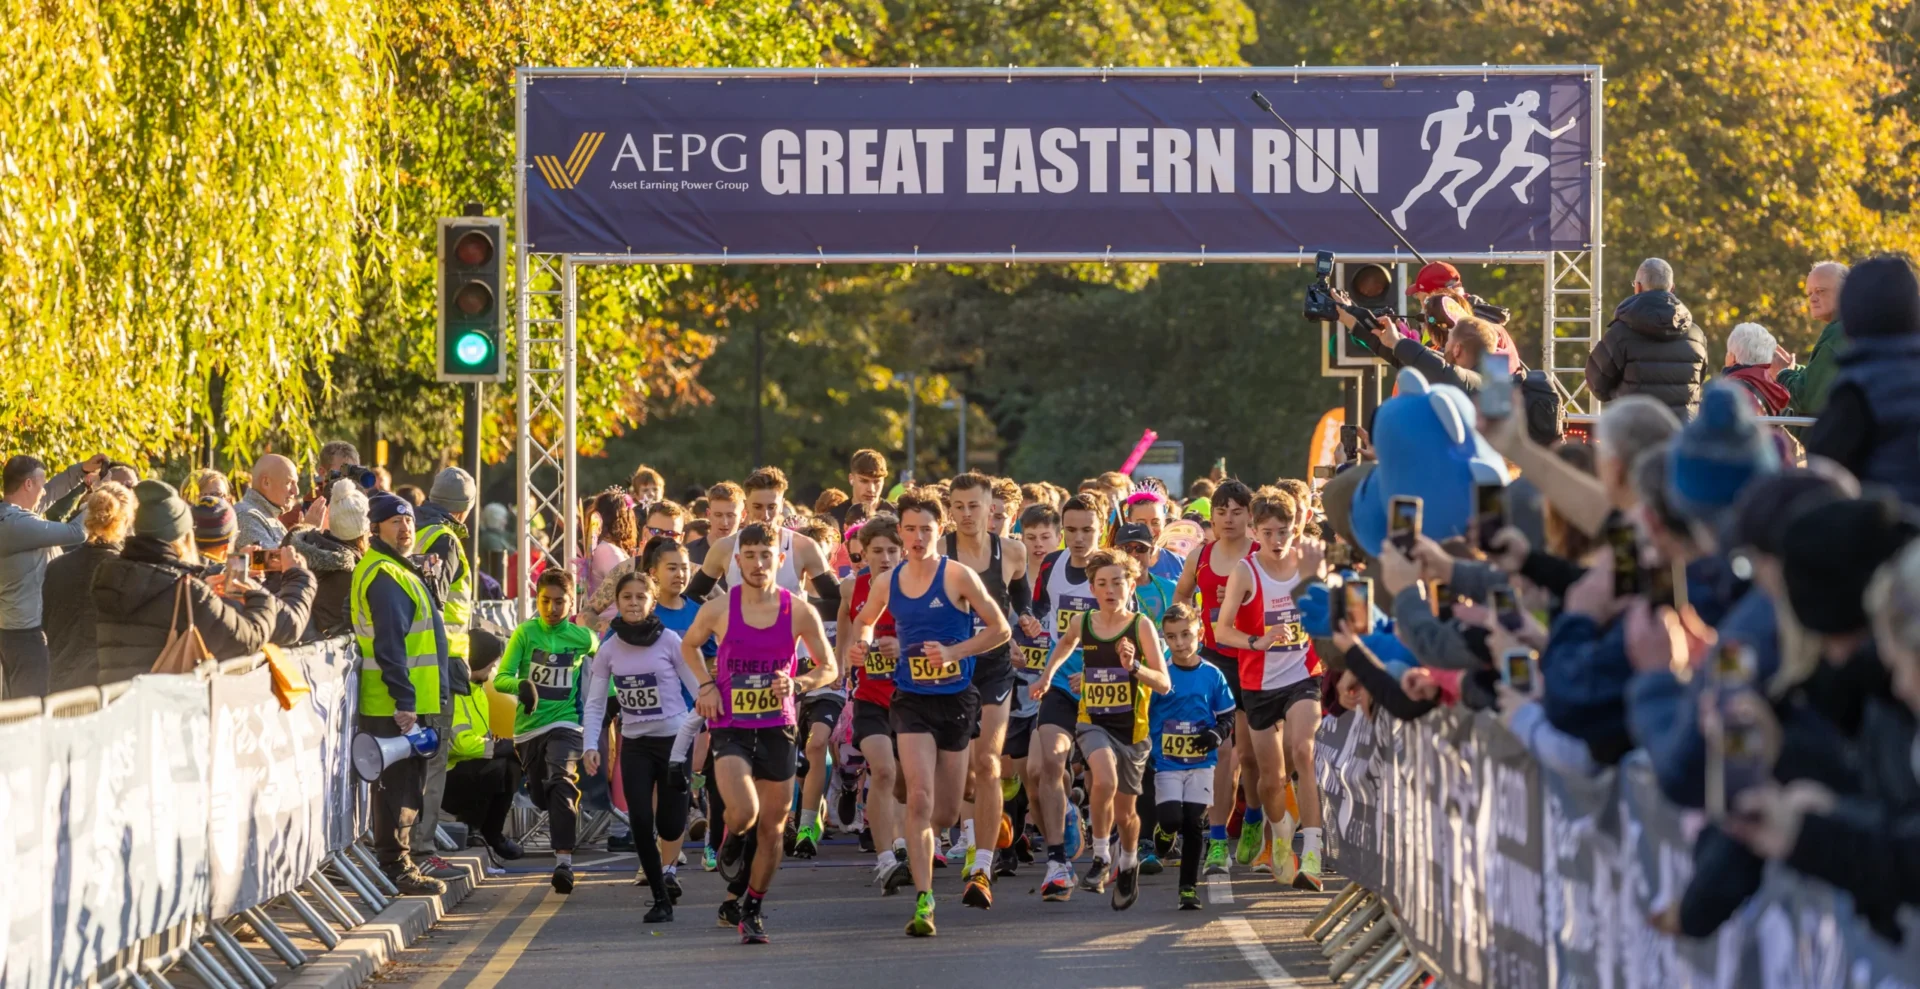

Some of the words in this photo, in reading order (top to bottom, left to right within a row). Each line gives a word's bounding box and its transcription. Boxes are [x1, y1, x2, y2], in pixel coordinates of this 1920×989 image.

[610, 132, 748, 173] AEPG
[760, 128, 954, 195] GREAT
[965, 127, 1235, 194] EASTERN
[1252, 127, 1379, 194] RUN
[609, 180, 637, 190] Asset
[640, 180, 679, 192] Earning
[681, 180, 713, 190] Power
[715, 180, 749, 192] Group
[531, 665, 569, 686] 6211
[617, 688, 658, 707] 3685
[734, 690, 779, 711] 4968
[1087, 684, 1128, 704] 4998
